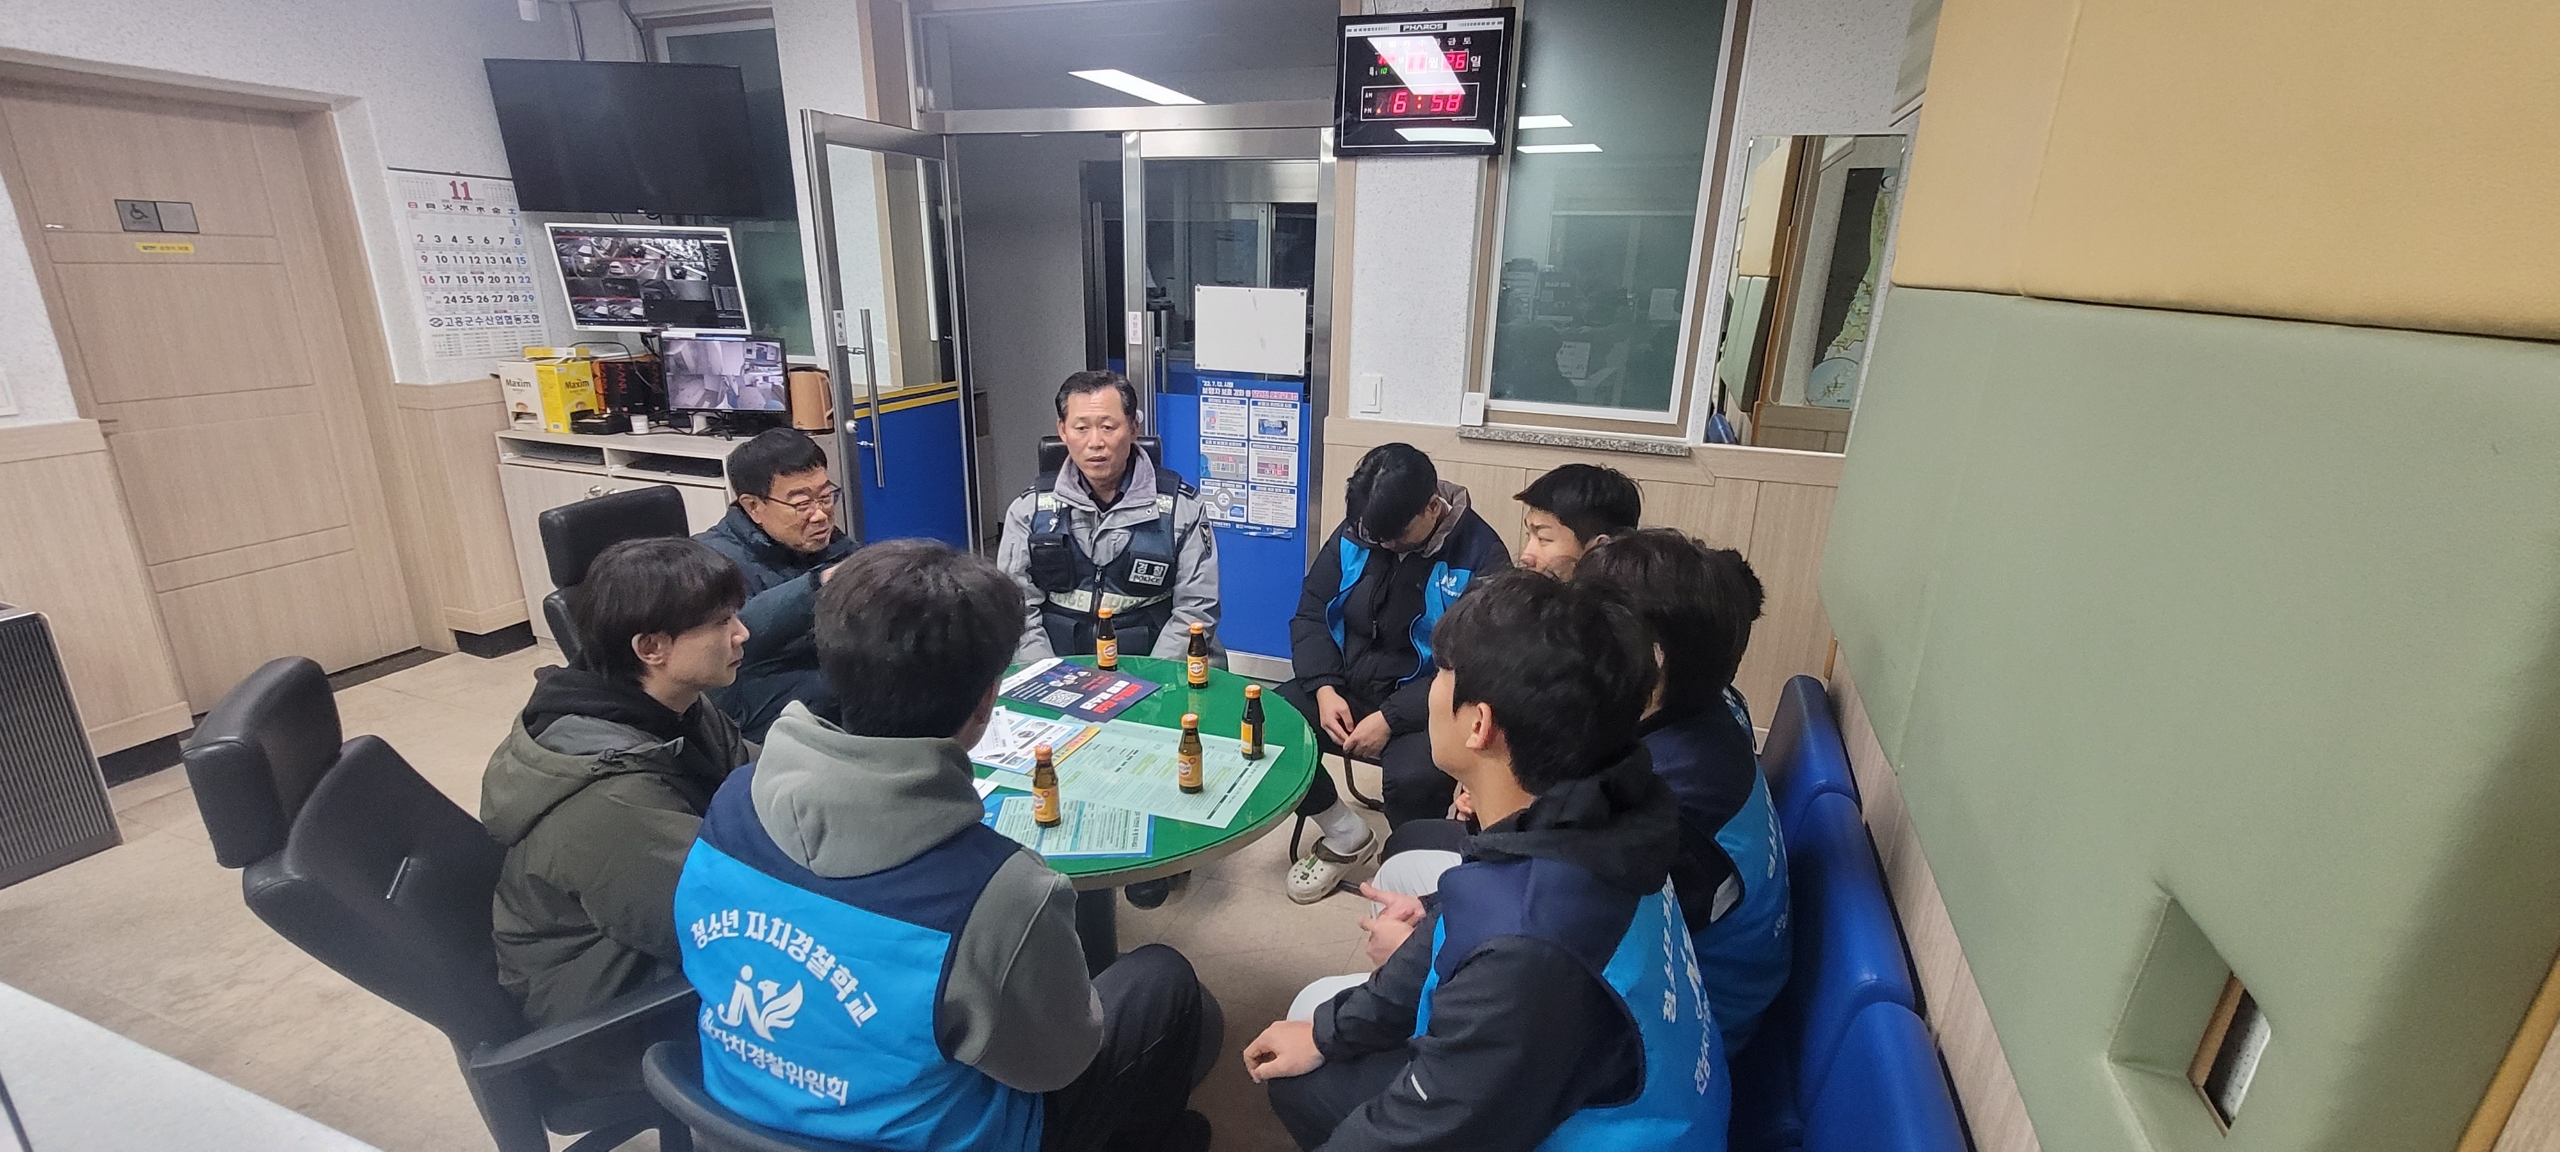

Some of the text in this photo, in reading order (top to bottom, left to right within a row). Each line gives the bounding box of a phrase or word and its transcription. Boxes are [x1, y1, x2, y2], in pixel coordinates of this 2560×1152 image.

[1402, 23, 1444, 31] PHAROS
[1447, 37, 1456, 46] 금
[1462, 37, 1472, 45] 토
[1470, 55, 1481, 68] 일
[449, 180, 474, 201] 11
[512, 218, 517, 227] 1
[416, 234, 521, 246] 2 3 4 5 6 7 8
[420, 255, 527, 265] 9 10 11 12 13 14 15
[422, 275, 531, 284] 16 17 18 19 20 21 22
[443, 295, 457, 304] 24
[460, 295, 473, 304] 25
[476, 295, 489, 304] 26
[492, 294, 503, 303] 27
[507, 294, 520, 303] 28
[521, 294, 535, 303] 29
[445, 314, 540, 327] 고흥군수산업협동조합
[505, 378, 532, 388] Maxim
[565, 379, 590, 389] Maxim
[1133, 574, 1160, 584] POLICE
[690, 909, 879, 1028] 청소년 자치경찰학교
